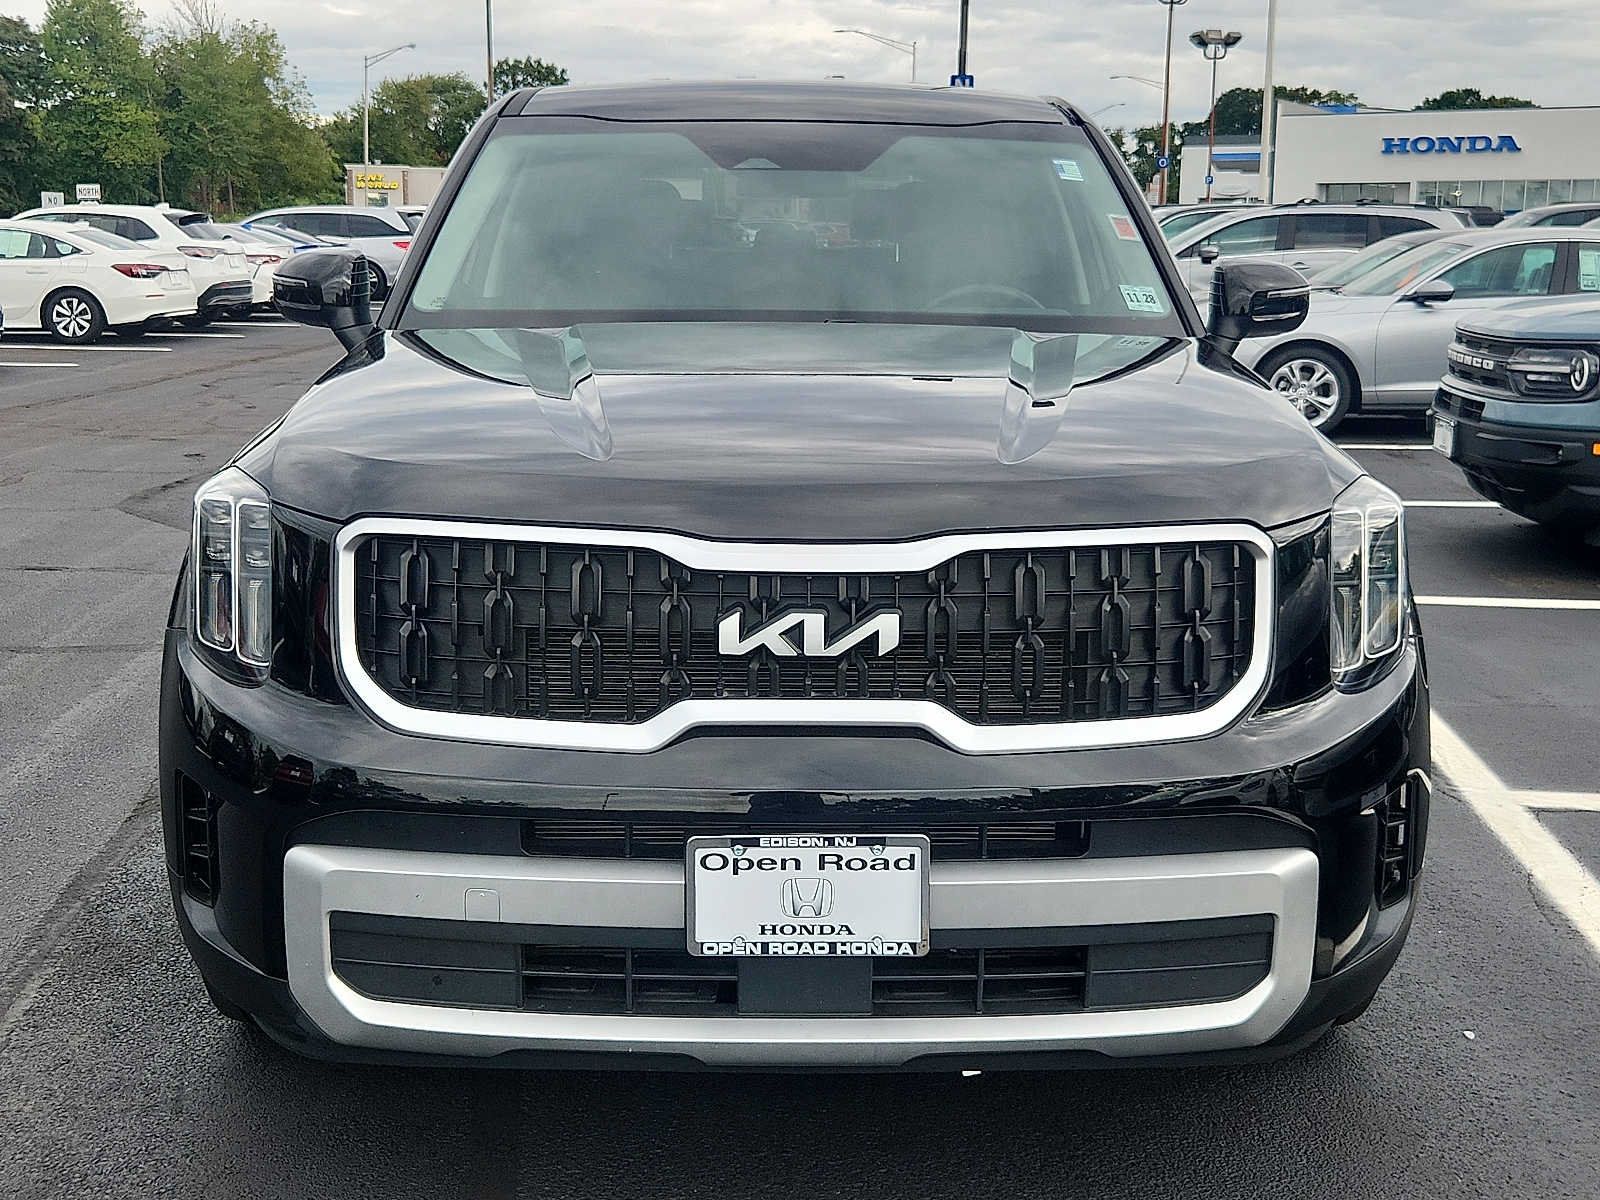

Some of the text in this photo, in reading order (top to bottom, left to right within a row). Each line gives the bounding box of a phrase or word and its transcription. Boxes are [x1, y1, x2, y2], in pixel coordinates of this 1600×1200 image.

[1381, 135, 1522, 153] HONDA
[78, 186, 99, 197] NORTH
[356, 181, 399, 189] WORLD
[47, 195, 58, 205] NO
[718, 610, 901, 657] KIA
[759, 836, 857, 848] EDISON, NJ
[699, 852, 916, 876] Open Road
[758, 923, 856, 936] HONDA
[702, 942, 914, 955] OPEN ROAD HONDA
